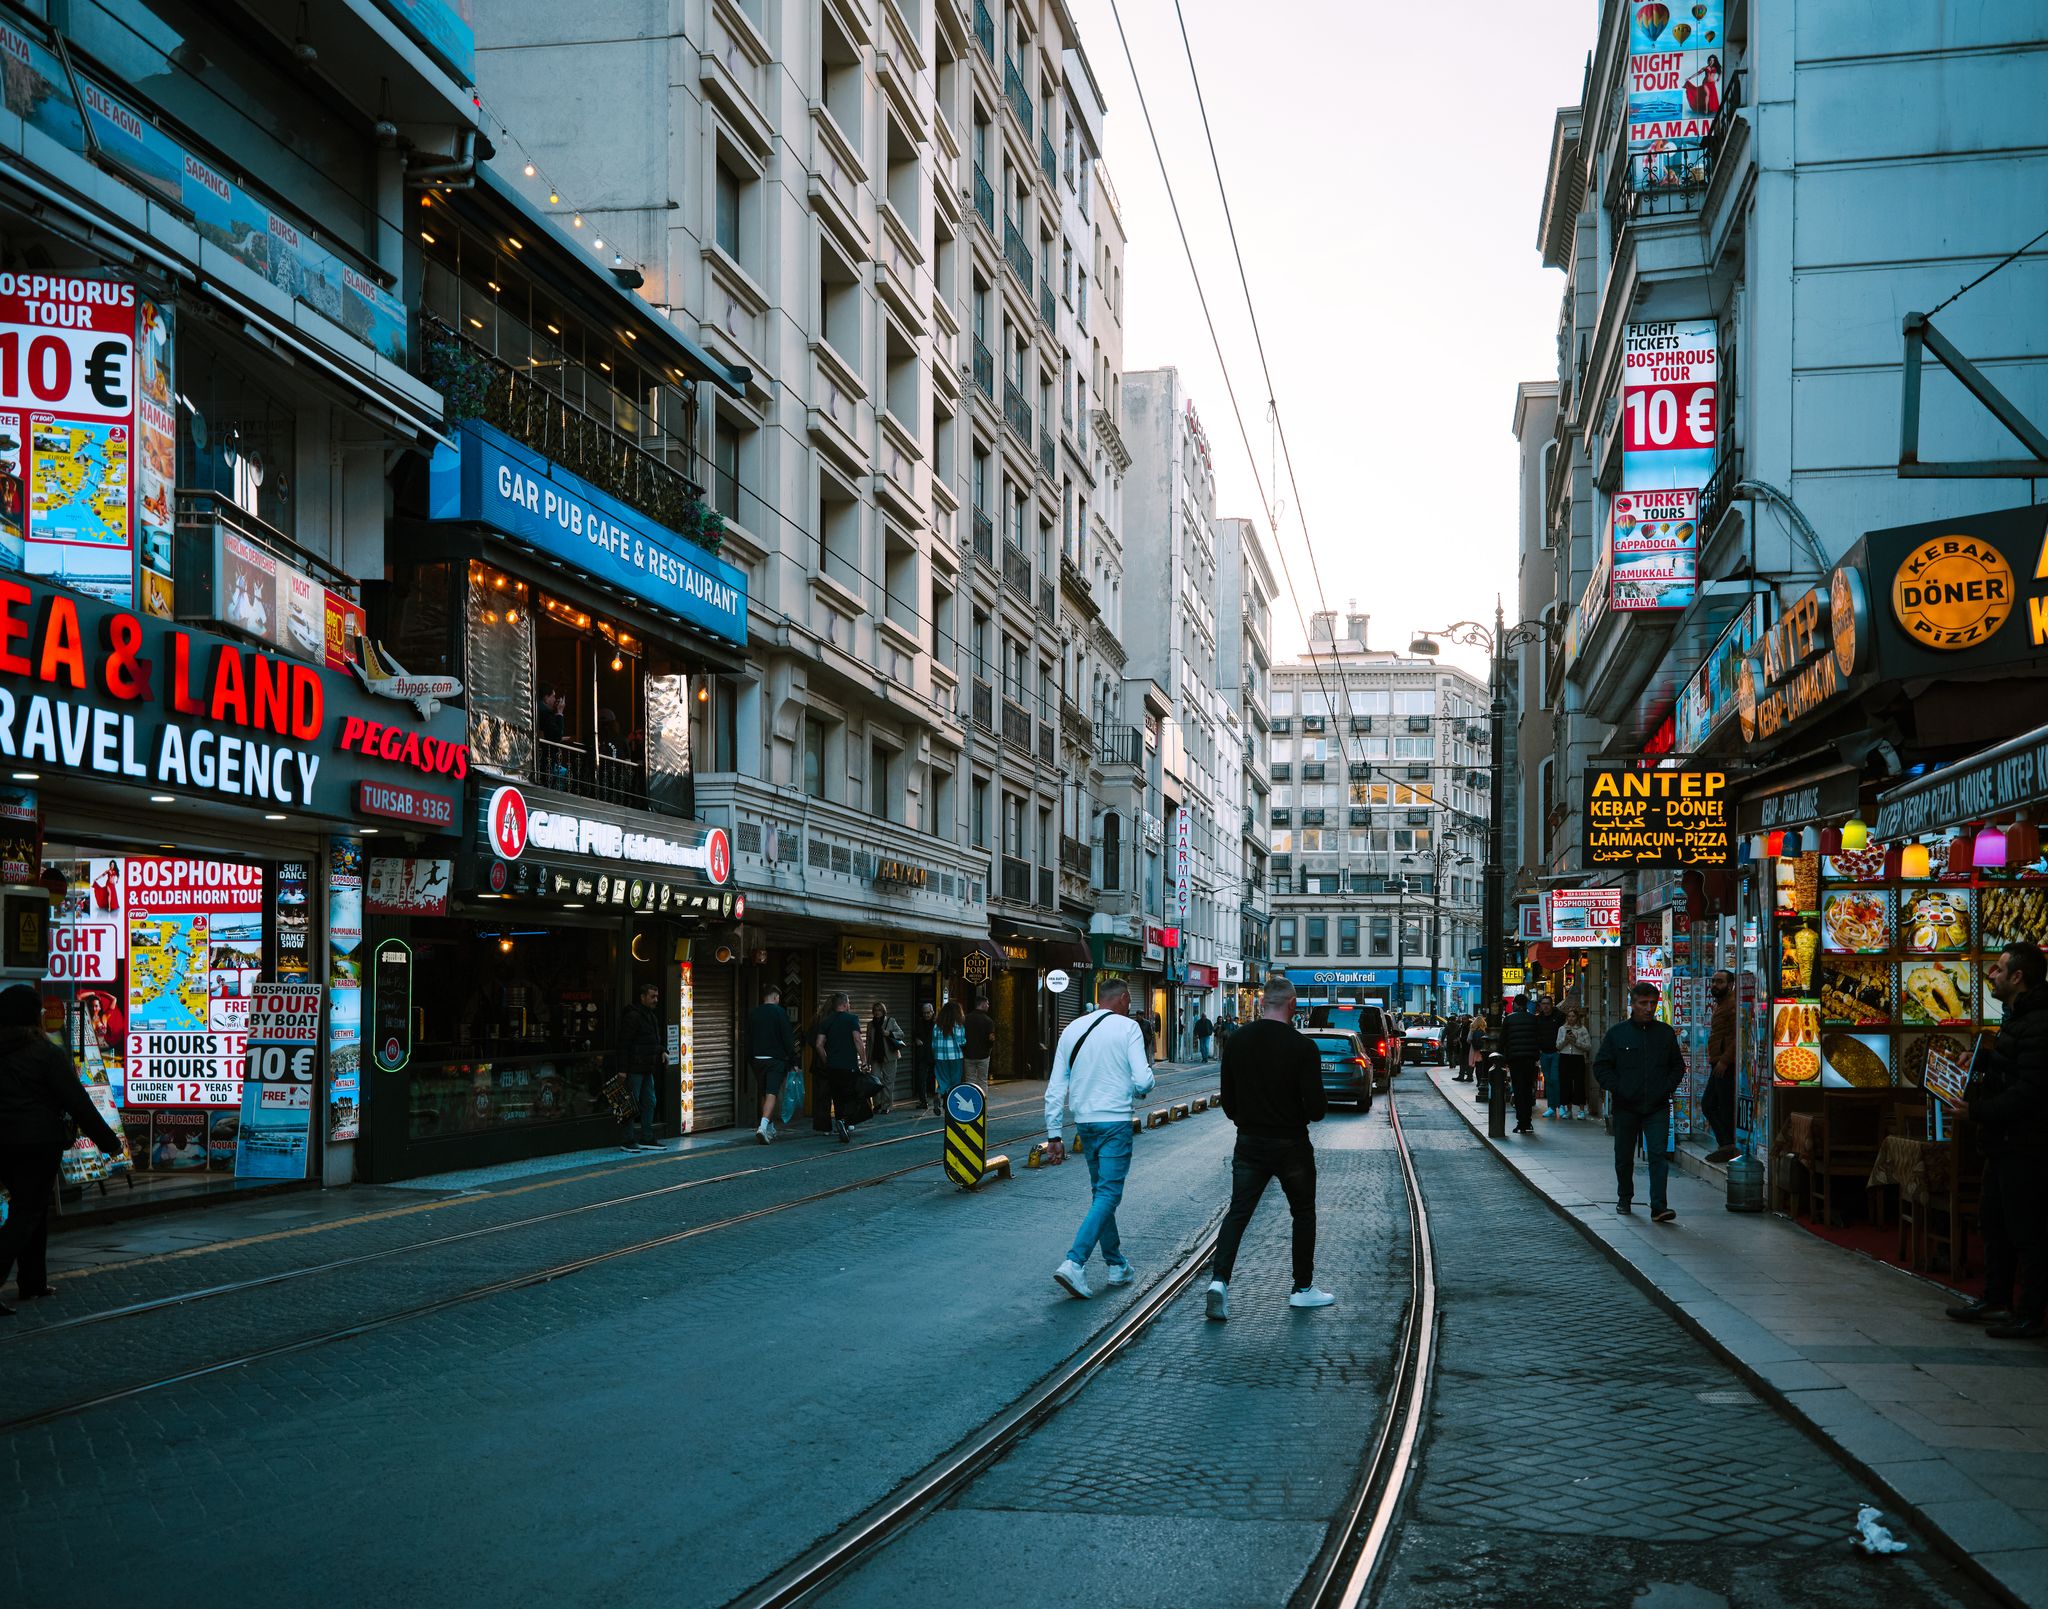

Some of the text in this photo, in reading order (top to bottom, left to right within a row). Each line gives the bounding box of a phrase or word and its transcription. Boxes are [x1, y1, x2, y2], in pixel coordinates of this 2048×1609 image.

[1631, 53, 1683, 74] NIGHT
[1633, 72, 1680, 92] TOUR
[85, 86, 142, 140] SILE AGVA
[185, 156, 231, 200] SAPANCA
[269, 216, 299, 248] BURSA
[343, 265, 377, 302] ISLANDS
[25, 300, 92, 328] TOUR
[1629, 323, 1677, 338] FLIGHT
[1627, 336, 1680, 351] TICKETS
[1627, 349, 1715, 368] BOSPHROUS
[0, 331, 127, 408] 10 €
[1651, 366, 1690, 382] TOUR
[141, 402, 174, 434] HAMAM
[1626, 387, 1715, 446] 10 €
[1634, 491, 1695, 508] TURKEY
[1643, 508, 1685, 520] TOURS
[499, 466, 738, 616] GAR PUB CAFE & RESTAURANT
[1615, 539, 1677, 551] CAPPADOCIA
[1908, 542, 1997, 574] KEBAP
[1615, 567, 1674, 579] PAMUKKALE
[292, 576, 310, 599] YACHT
[1904, 579, 2005, 607] DÖNER
[1615, 597, 1657, 607] ANTALYA
[1764, 589, 1818, 688] ANTEP
[0, 580, 325, 741] EA & LAND
[396, 677, 452, 696] flypgs.com
[341, 716, 470, 780] PEGASUS
[158, 723, 320, 806] AGENCY
[1592, 773, 1725, 797] ANTEP
[1903, 791, 1930, 835] KEBAP
[1959, 767, 1994, 815] HOUSE
[1997, 752, 2033, 804] ANTEP
[364, 786, 450, 821] TURSAB 9362
[1591, 801, 1647, 816] KEBAP
[1592, 817, 1646, 830] كباب
[4, 863, 29, 873] DANCE
[284, 864, 303, 872] SUFI
[1178, 809, 1188, 917] PHARMACY
[4, 873, 28, 882] SHOW
[280, 871, 307, 880] DANCE
[331, 875, 361, 885] CAPPADOCIA
[129, 891, 138, 905] &
[141, 890, 191, 905] GOLDEN
[194, 890, 229, 905] HORN
[1598, 899, 1620, 907] TOURS
[1591, 910, 1620, 924] 10 €
[281, 934, 305, 942] DANCE
[50, 954, 100, 977] OUR
[253, 985, 321, 996] BOSPHORUS
[334, 979, 357, 988] TRABZON
[255, 995, 318, 1013] TOUR
[1674, 978, 1682, 1026] HAMAM
[251, 1014, 318, 1028] BY BOAT
[251, 1027, 317, 1040] 2 HOURS
[334, 1030, 354, 1038] FETHIYE
[132, 1036, 247, 1054] 3 HOURS 15
[132, 1060, 246, 1078] 2 HOURS 10
[250, 1048, 315, 1081] 10 €
[131, 1083, 232, 1101] CHILDREN 12 YERAS
[335, 1079, 355, 1088] ANTALYA
[211, 1094, 227, 1102] OLD
[263, 1090, 286, 1101] FREE
[126, 1116, 149, 1124] SHOW
[157, 1116, 204, 1125] SUFI DANCE
[335, 1130, 354, 1139] EPHESUS
